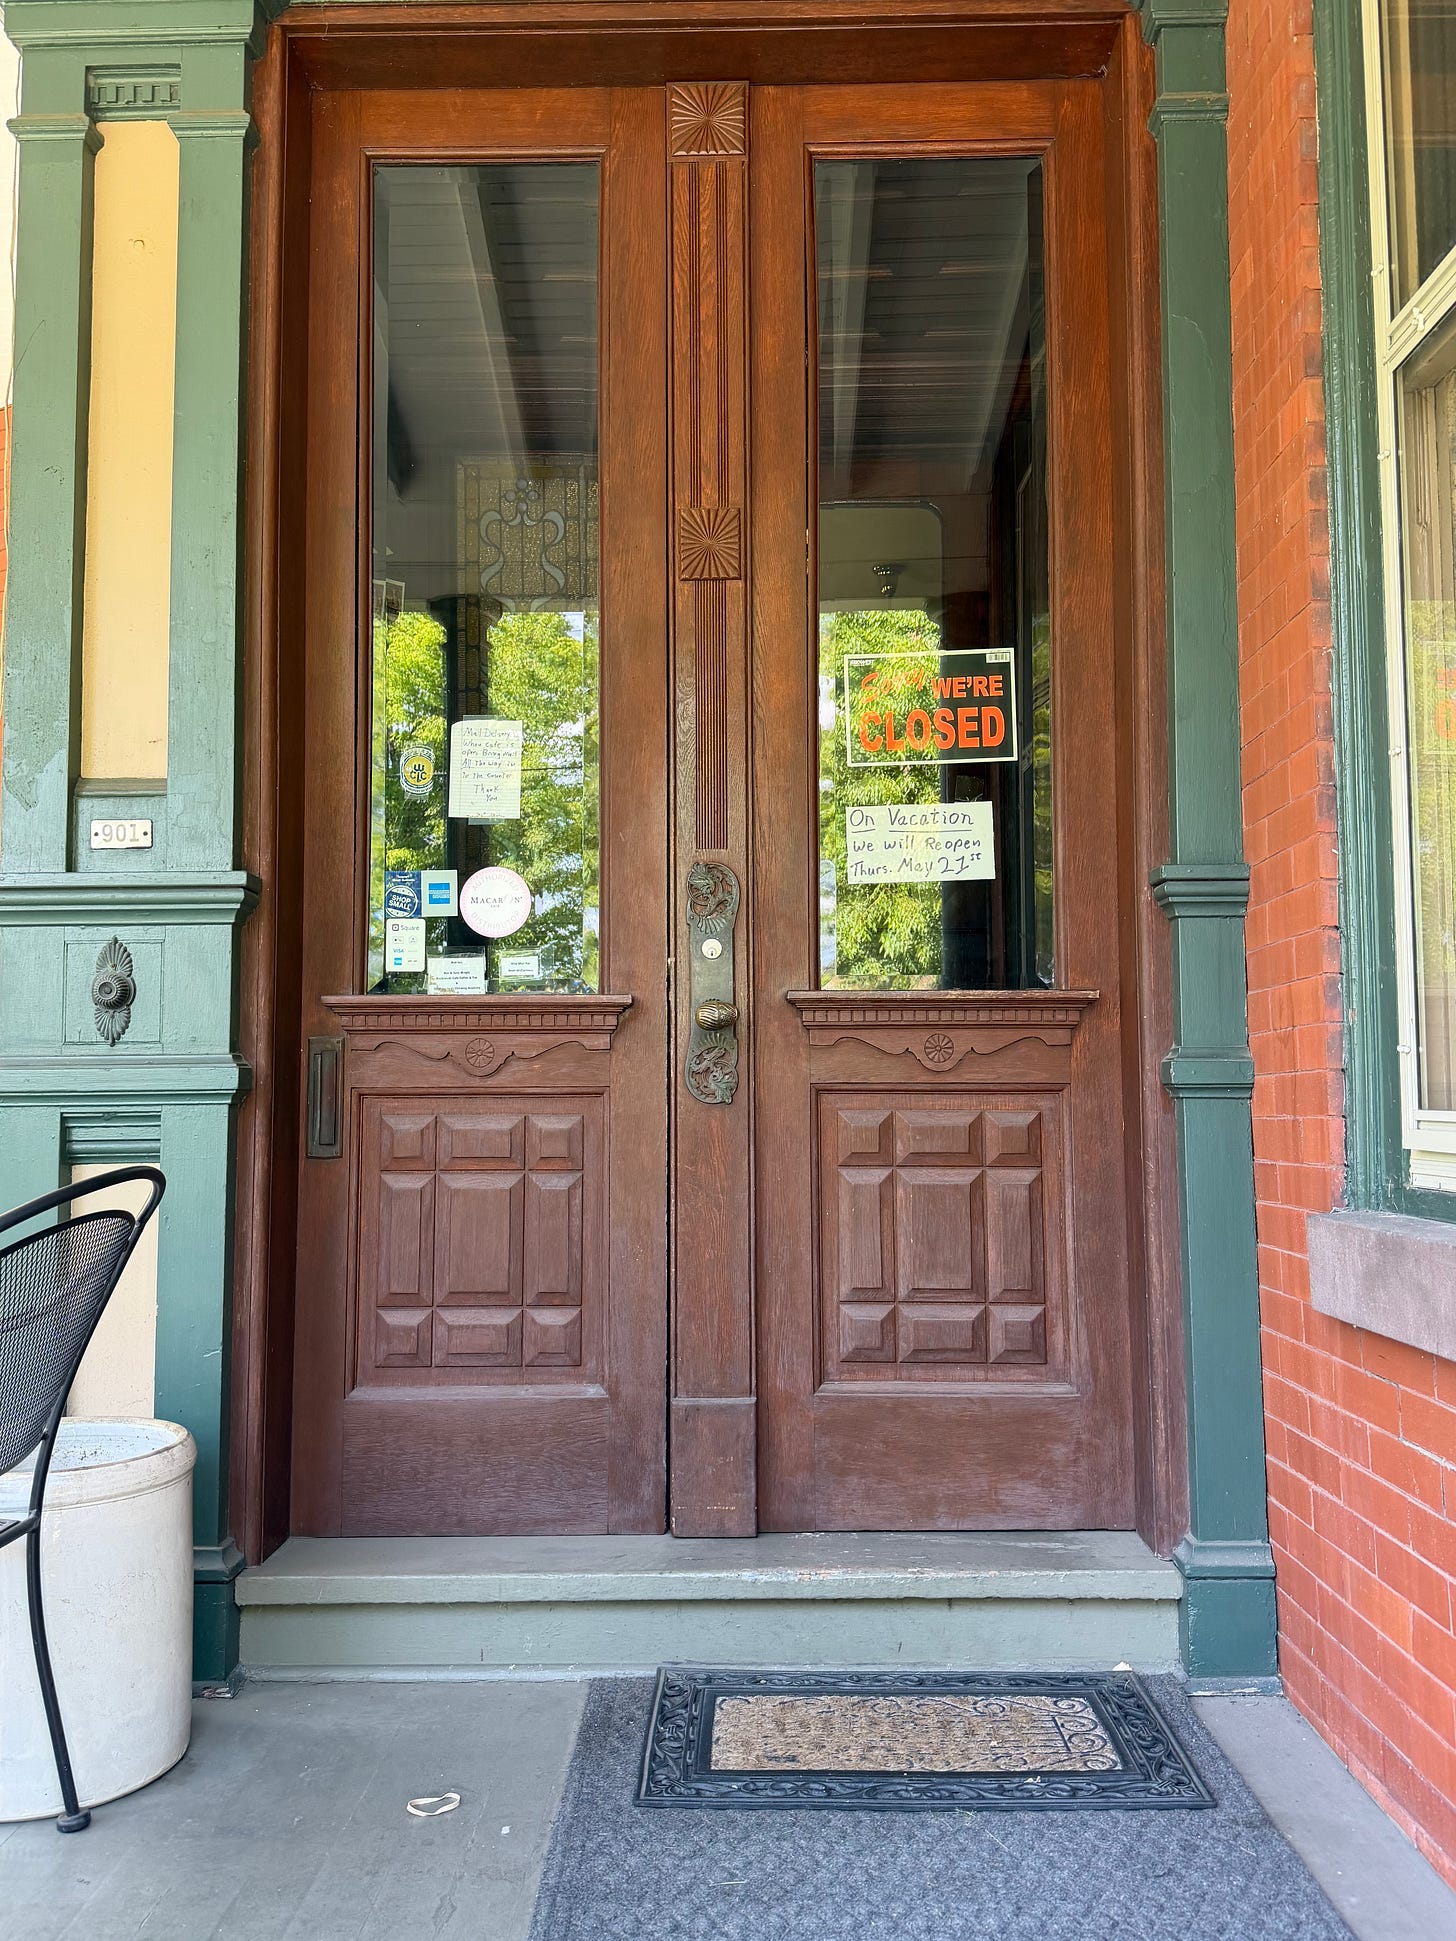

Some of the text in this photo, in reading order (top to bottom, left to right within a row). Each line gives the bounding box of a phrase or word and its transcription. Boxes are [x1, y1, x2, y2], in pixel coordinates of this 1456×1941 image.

[931, 675, 1004, 700] WE'RE
[859, 706, 1005, 752] CLOSED
[850, 807, 974, 827] On Vacation
[102, 824, 139, 842] 901
[925, 836, 981, 852] Reopen
[850, 861, 893, 877] Thurs.
[898, 857, 934, 878] May
[388, 899, 411, 911] SMALL
[392, 894, 411, 904] SHOP
